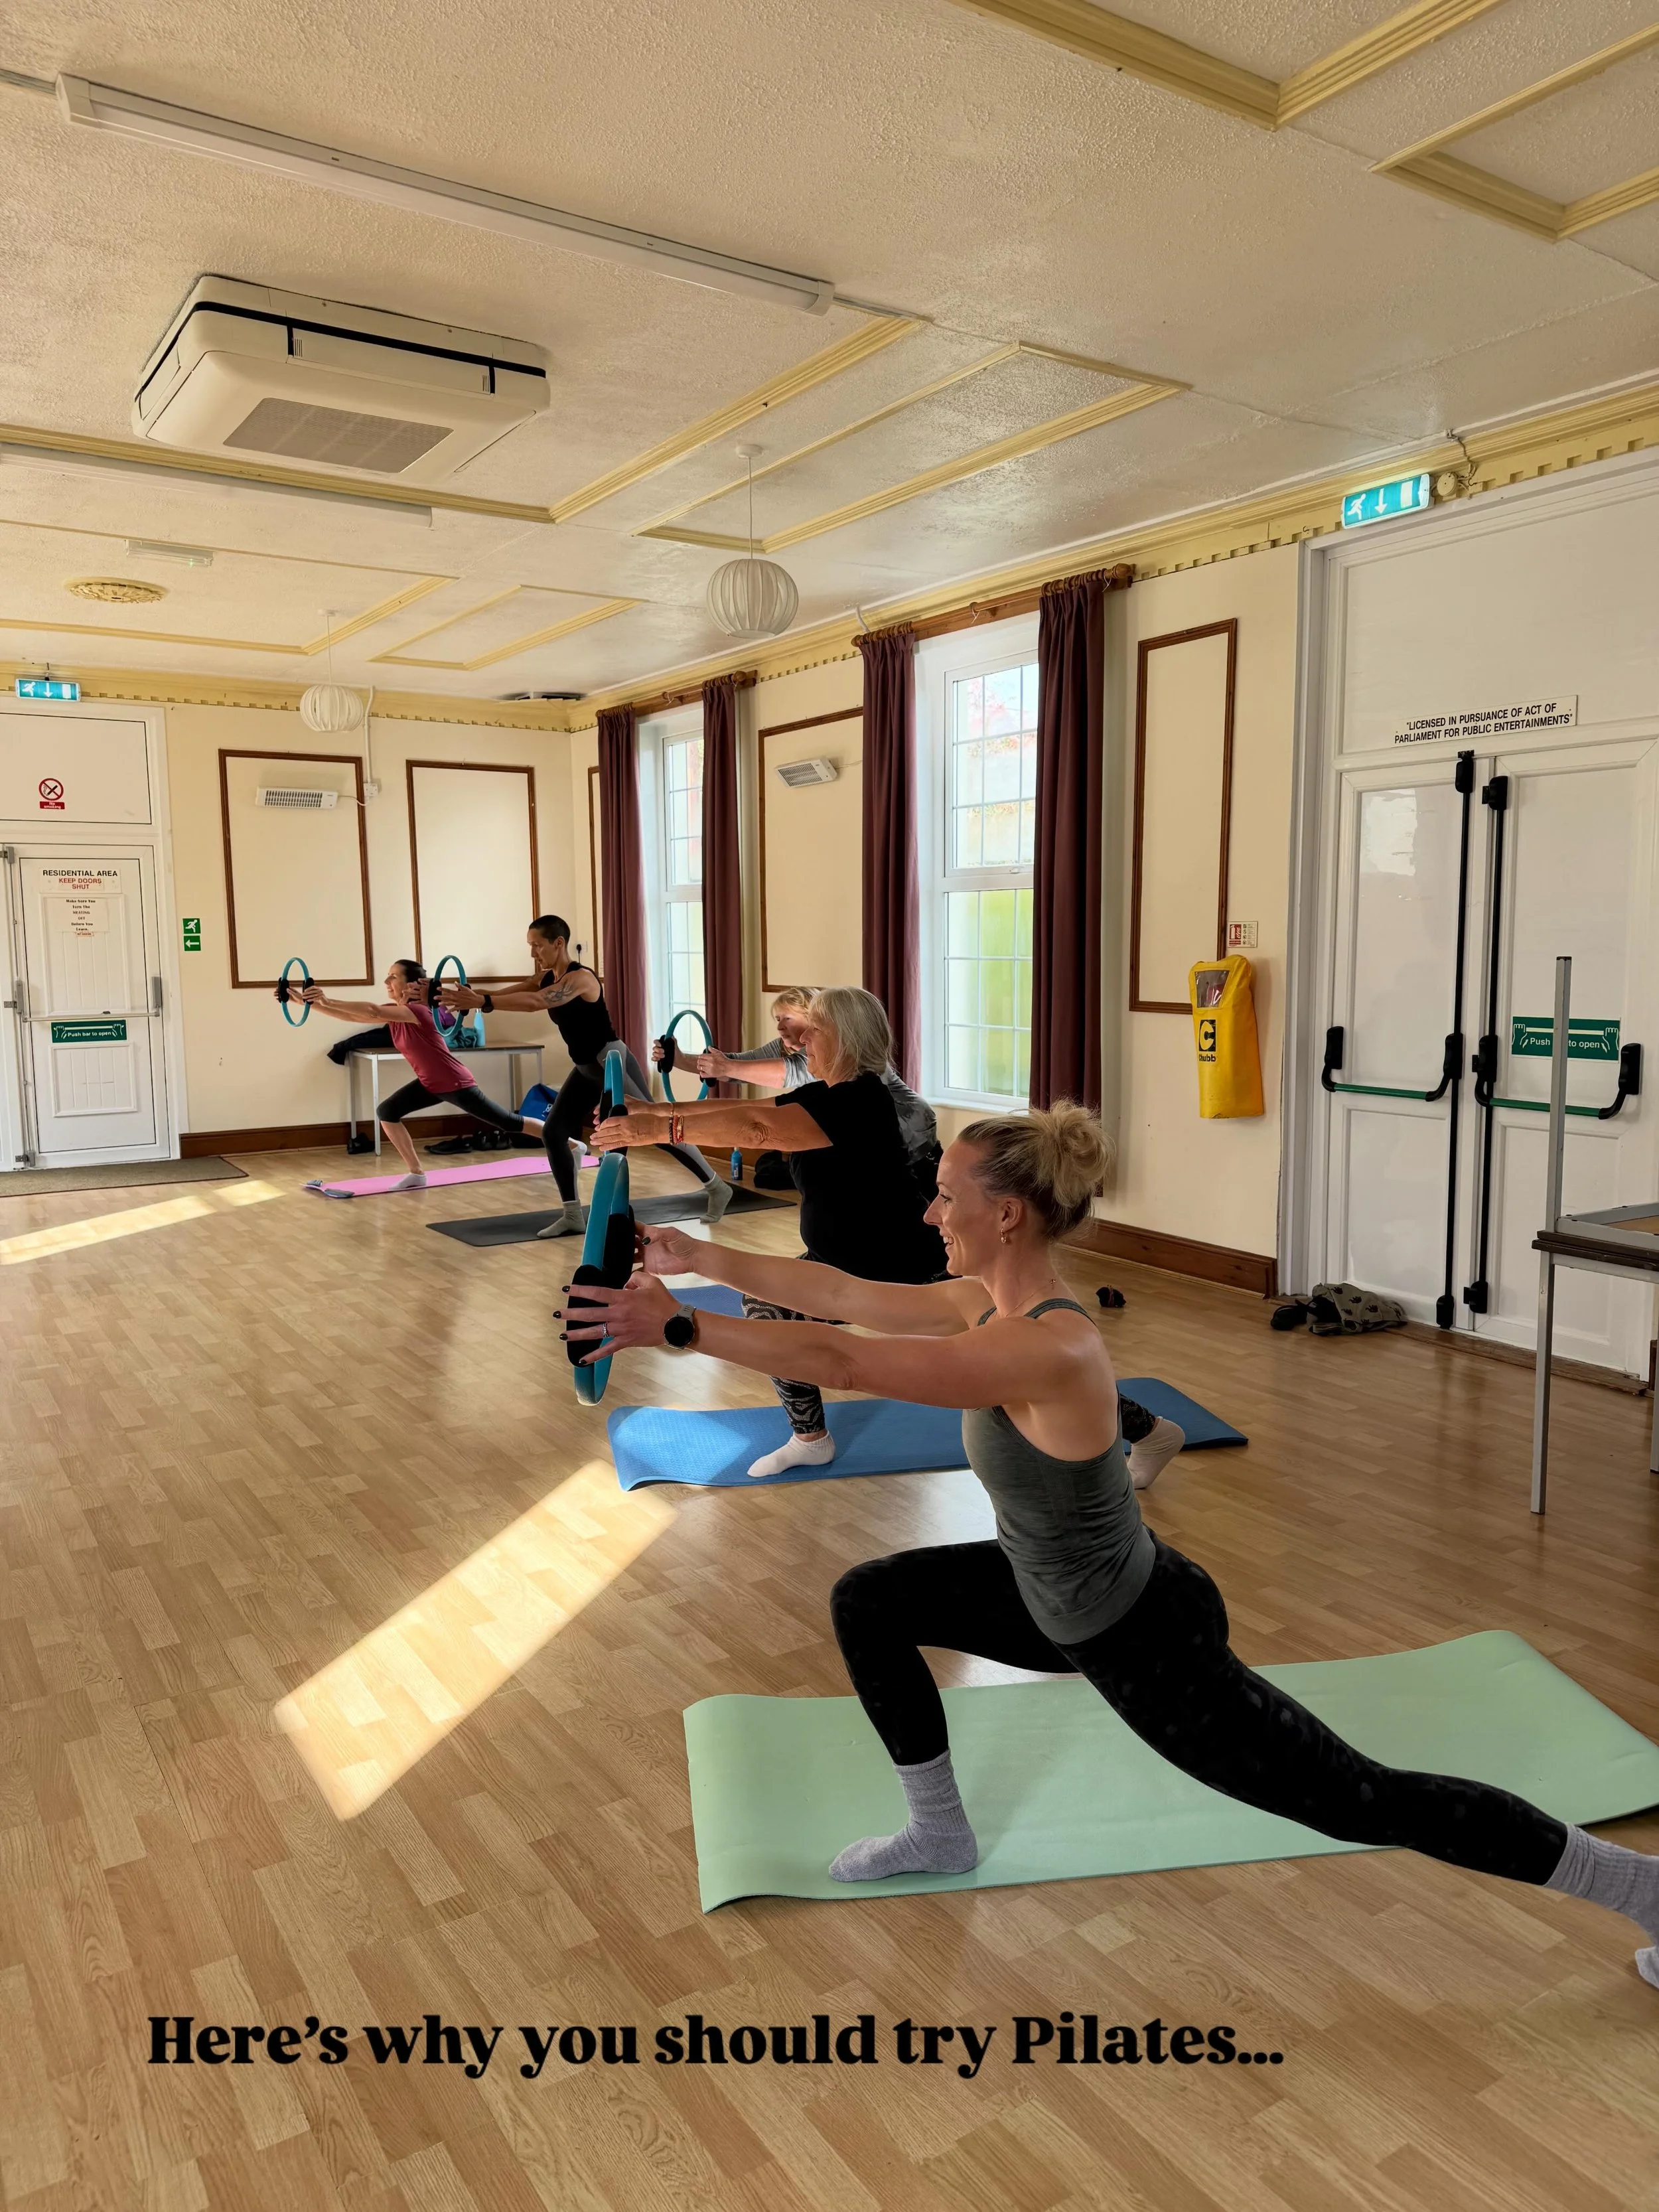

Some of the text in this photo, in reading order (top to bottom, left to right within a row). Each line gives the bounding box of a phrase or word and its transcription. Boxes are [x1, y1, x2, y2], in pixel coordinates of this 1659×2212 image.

[1449, 715, 1457, 725] IN
[1459, 711, 1508, 724] PURSUANCE
[1510, 707, 1522, 717] OF
[1525, 705, 1542, 715] ACT
[1544, 703, 1557, 713] OF
[1394, 730, 1442, 744] PARLIAMENT
[1444, 727, 1460, 737] FOR
[1462, 724, 1491, 736] PUBLIC
[1530, 1037, 1551, 1046] Push
